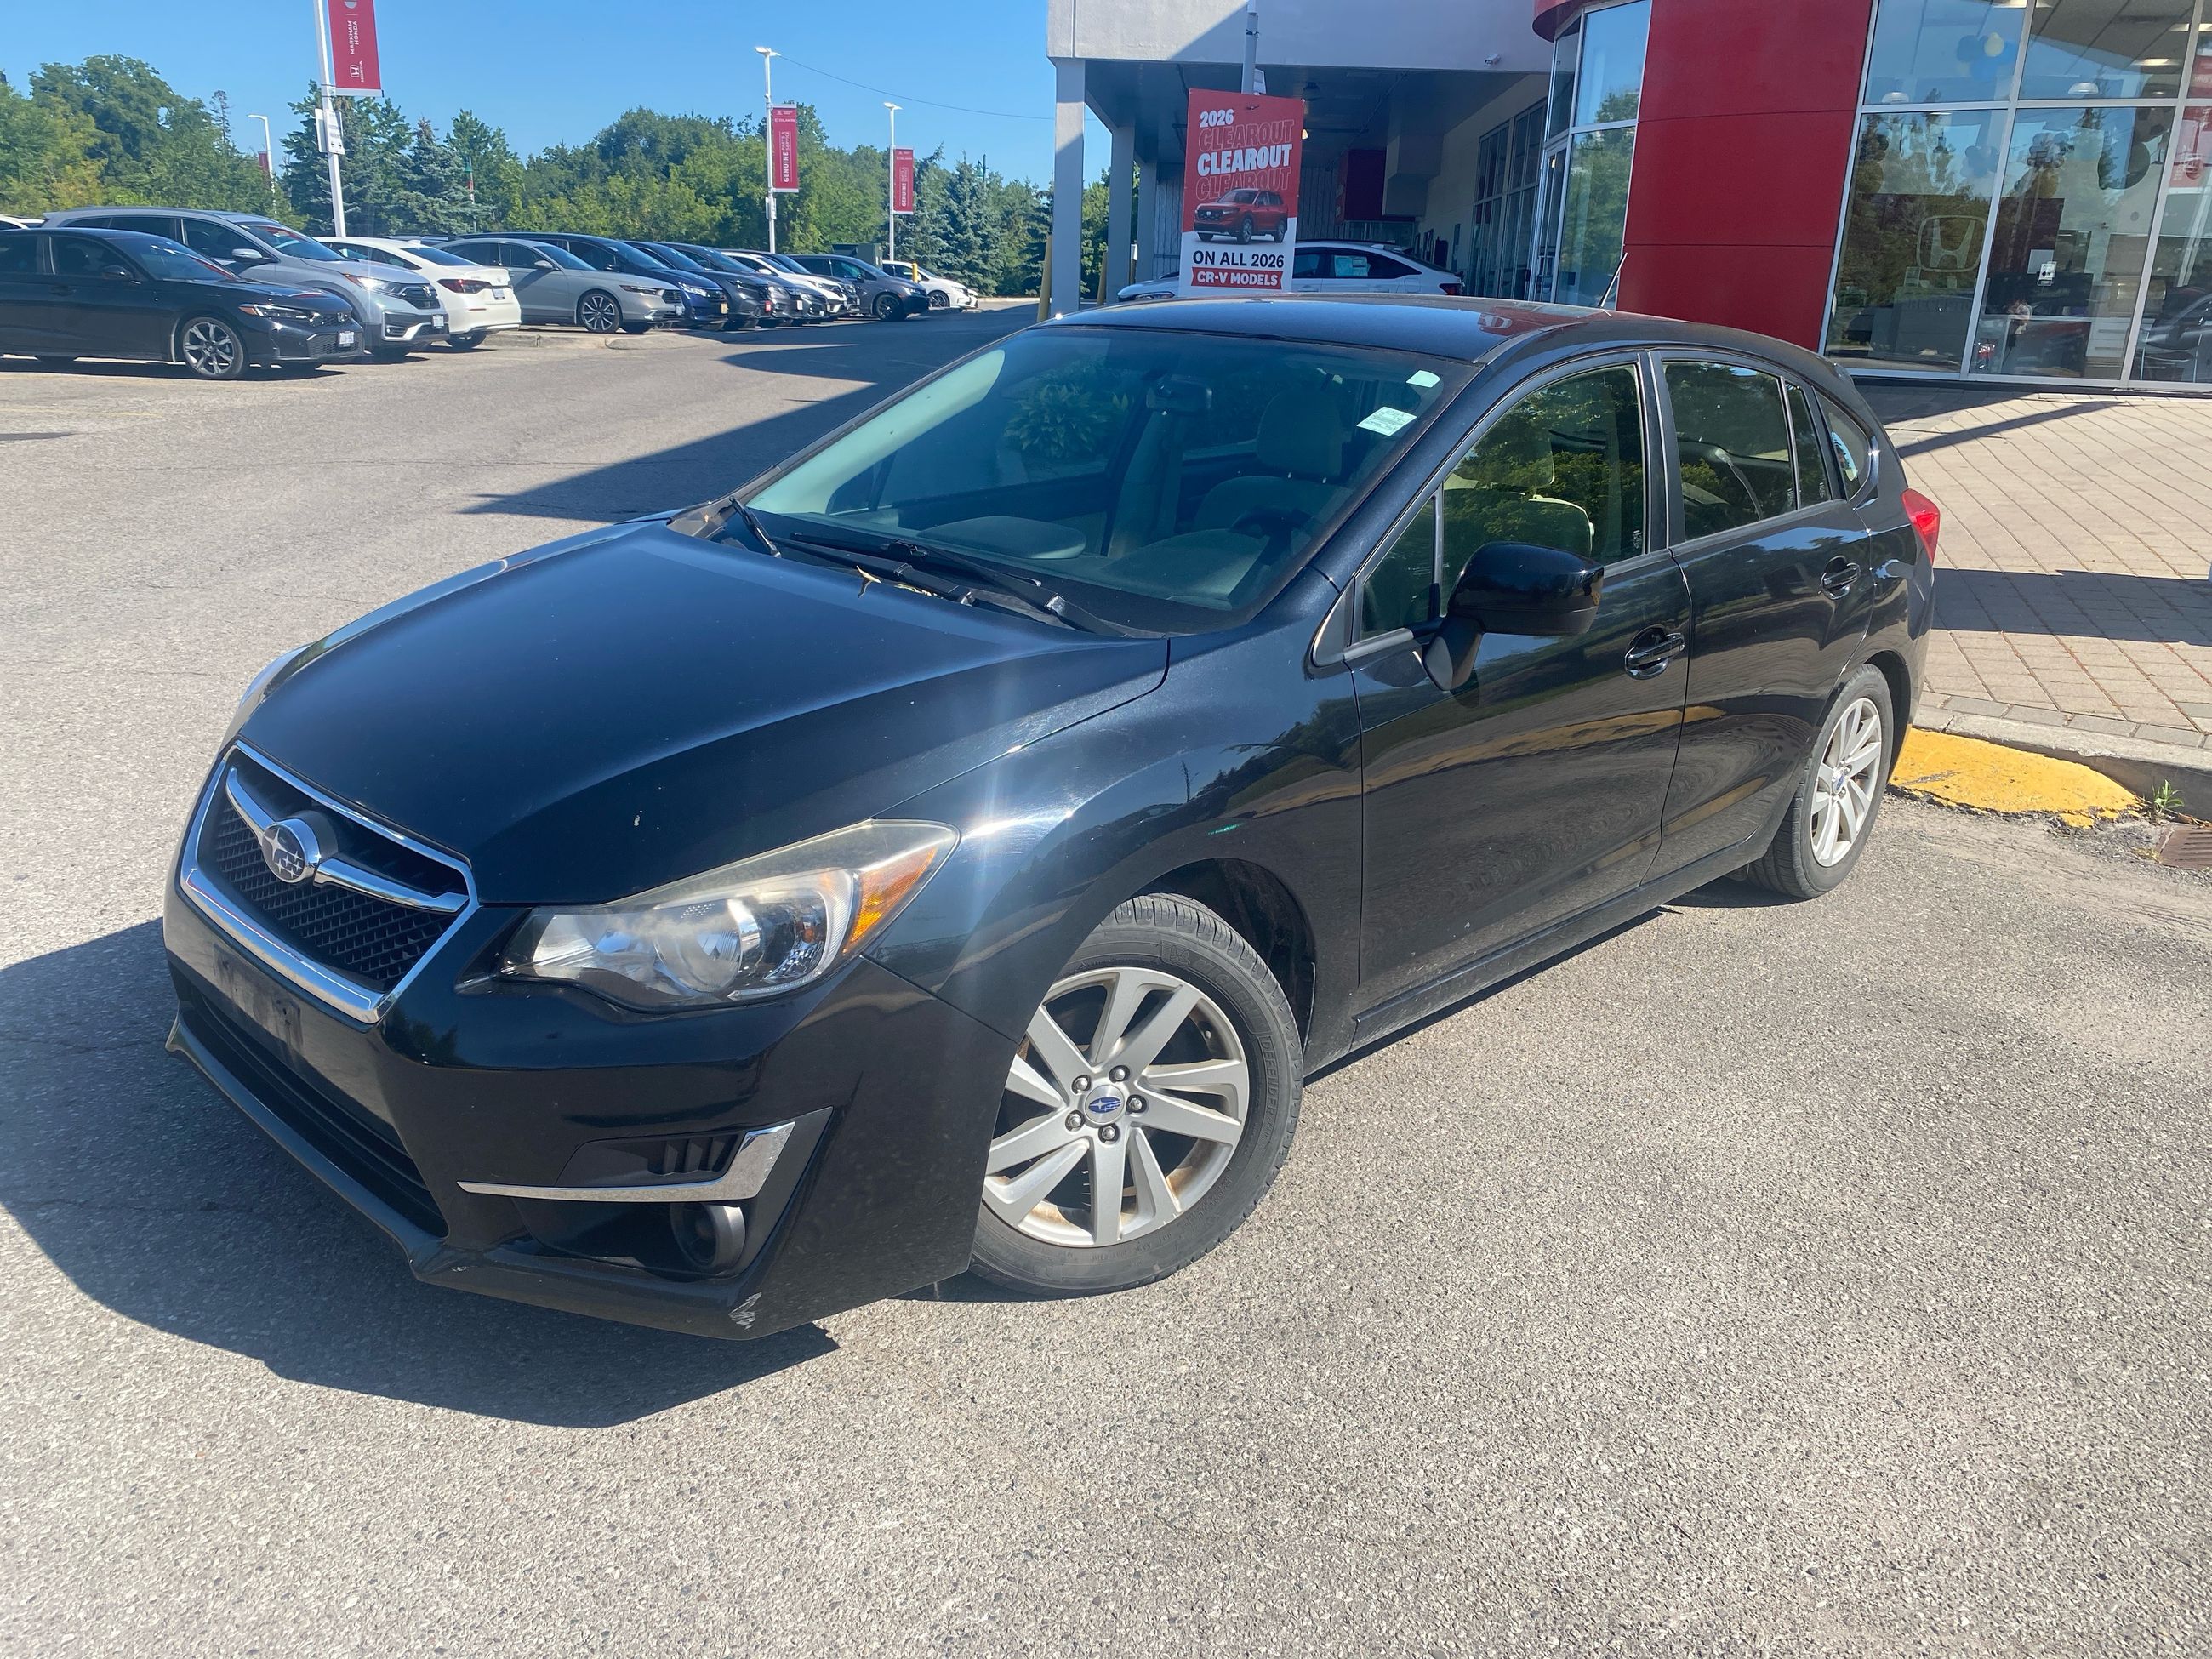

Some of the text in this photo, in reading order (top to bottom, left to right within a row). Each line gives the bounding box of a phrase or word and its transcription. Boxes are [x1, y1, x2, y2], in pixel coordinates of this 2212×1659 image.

[1200, 109, 1234, 128] 2026
[1198, 119, 1295, 151] CLEAROUT
[1197, 143, 1292, 177] CLEAROUT
[1193, 250, 1284, 268] ON ALL 2026
[1197, 271, 1278, 286] CR-V MODELS
[1194, 960, 1269, 1031] MICHELIN
[1261, 1040, 1279, 1116] DEFENDER
